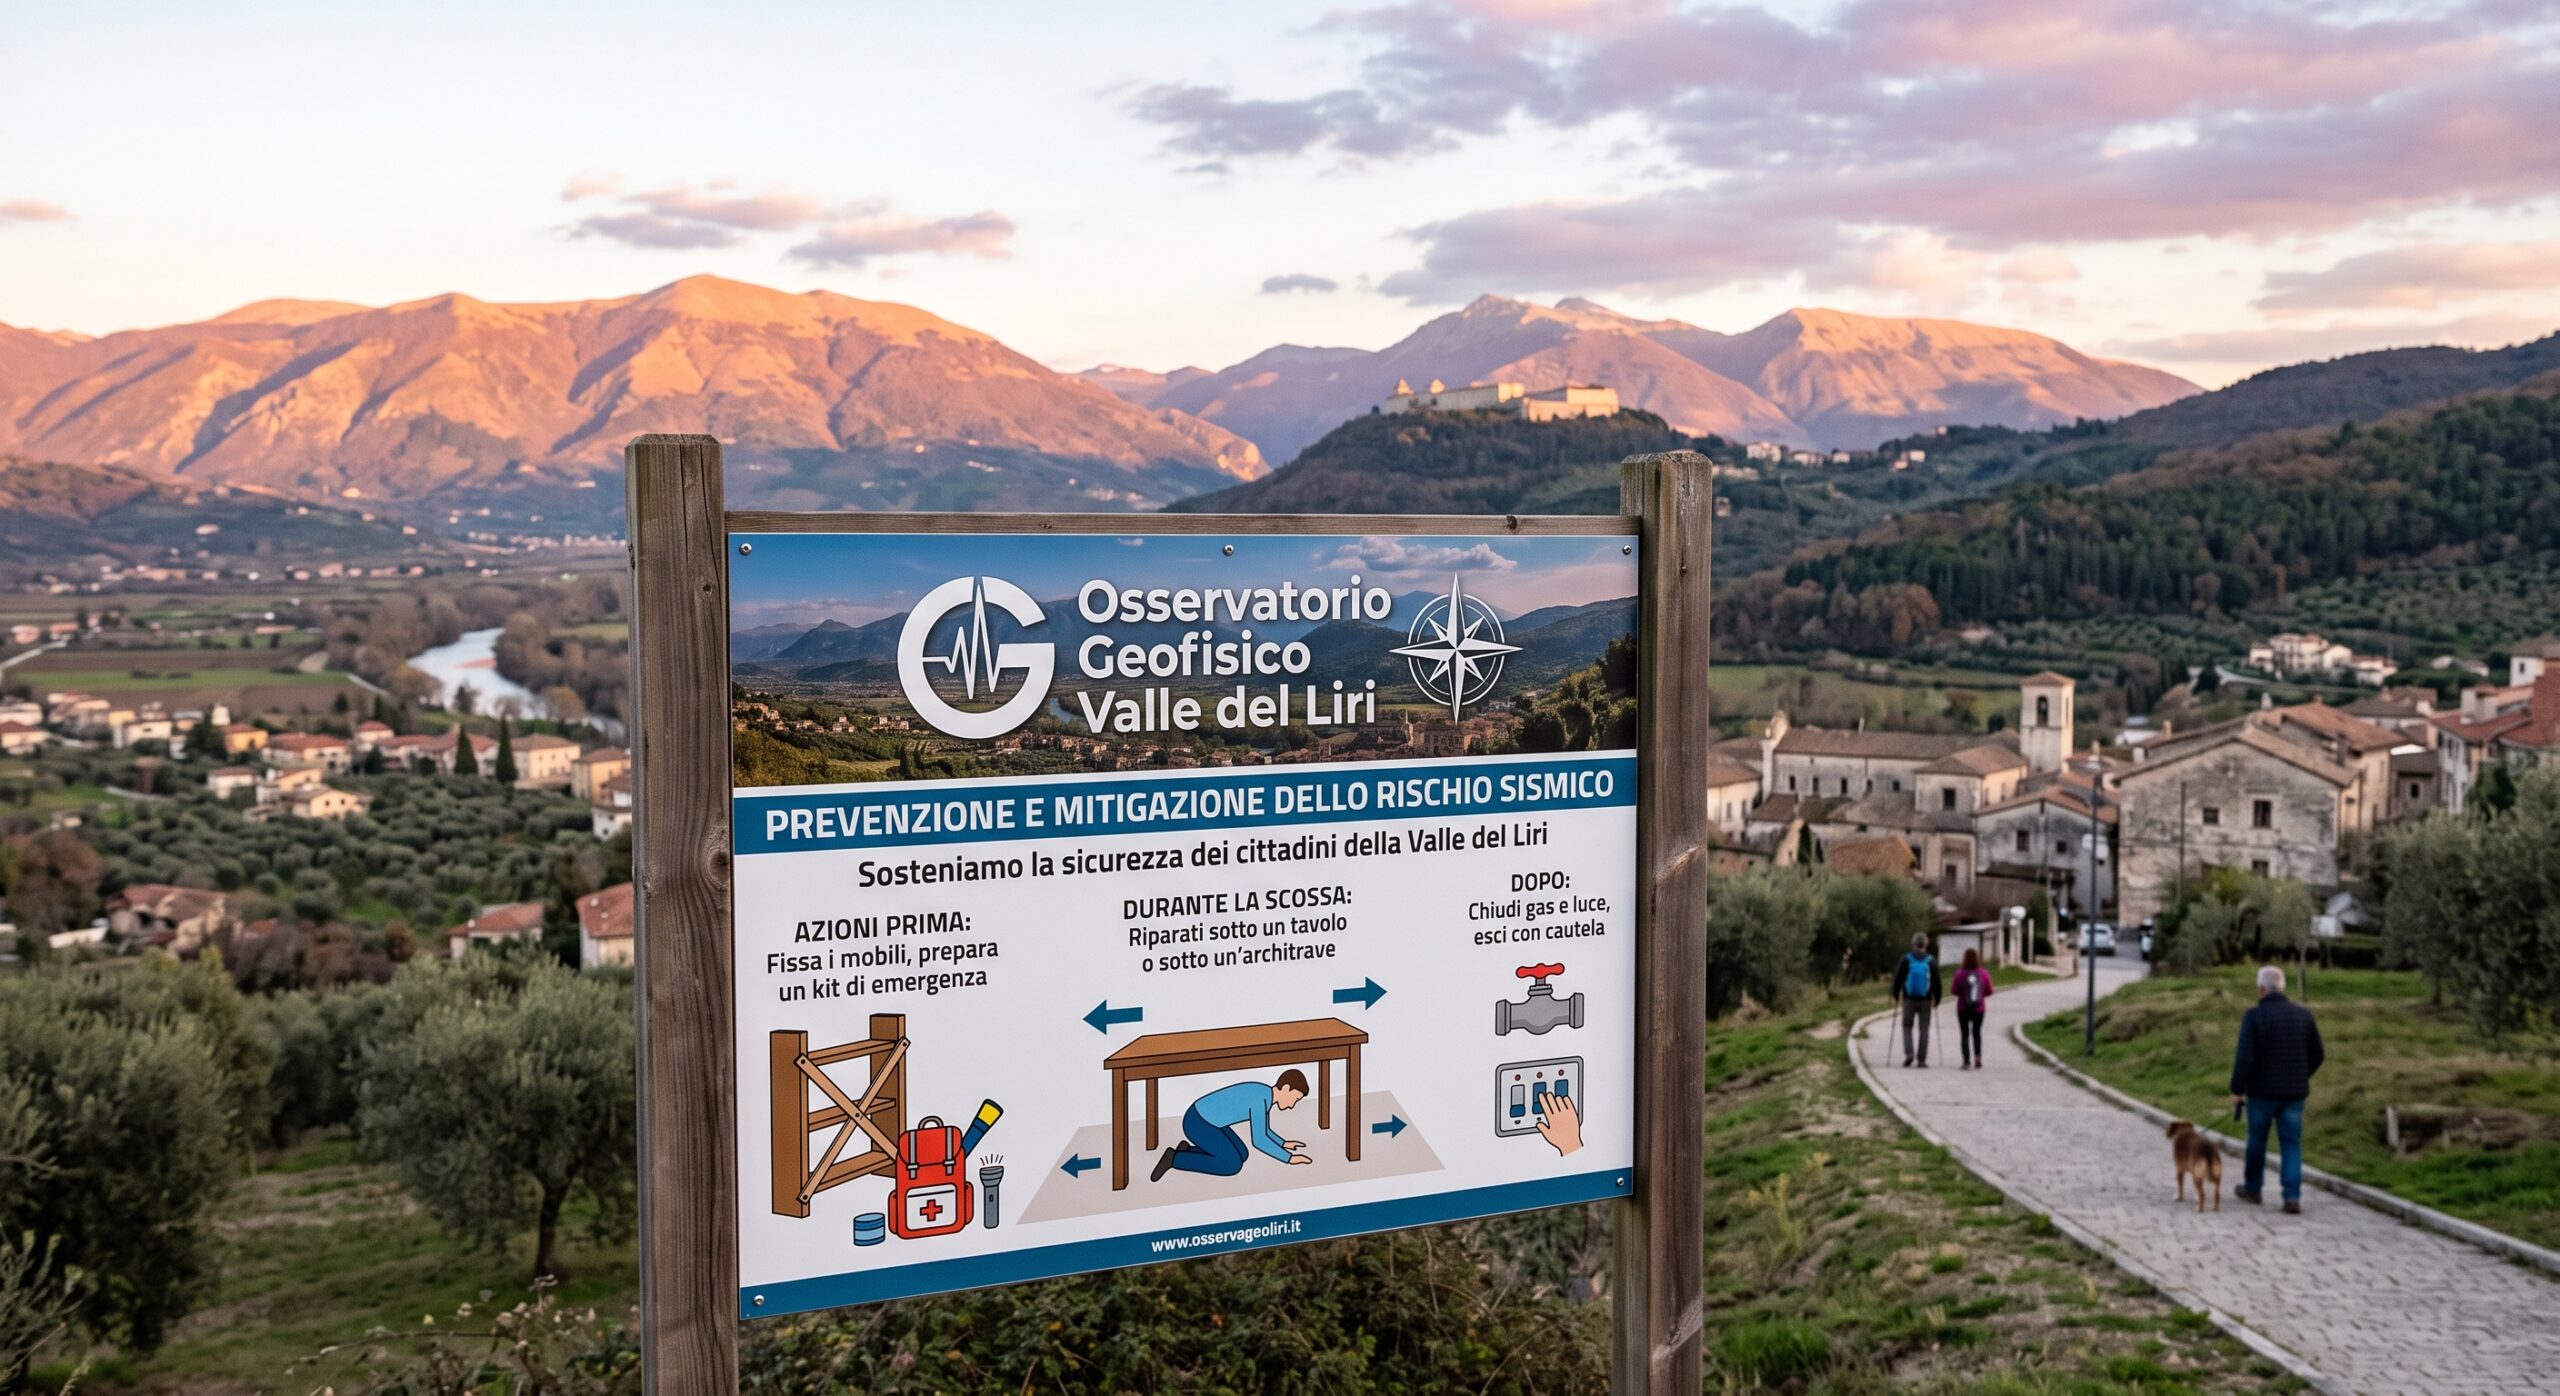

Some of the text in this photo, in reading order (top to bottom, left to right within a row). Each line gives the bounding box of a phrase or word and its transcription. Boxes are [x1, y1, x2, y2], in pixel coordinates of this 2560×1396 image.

[1078, 574, 1392, 623] Osservatorio
[1078, 629, 1311, 679] Geofisico
[1076, 679, 1375, 733] Valle del Liri
[766, 769, 1614, 841] PREVENZIONE E MITIGAZIONE DELLO RISCHIO SISMICO
[858, 820, 1548, 888] Sosteniamo la sicurezza dei cittadini della Valle del Liri
[1511, 870, 1570, 893] DOPO:
[1123, 885, 1352, 920] DURANTE LA SCOSSA:
[1468, 894, 1611, 922] Chiudi gas e luce,
[794, 911, 971, 944] AZIONI PRIMA:
[1129, 912, 1348, 951] Riparati sotto un tavolo
[1473, 918, 1606, 946] esci con cautela
[767, 941, 999, 974] Fissa i mobili, prepara
[1142, 942, 1336, 973] o sotto un'architrave
[779, 970, 988, 1002] un kit di emergenza
[1151, 1220, 1302, 1252] www.osservageoliri.it
